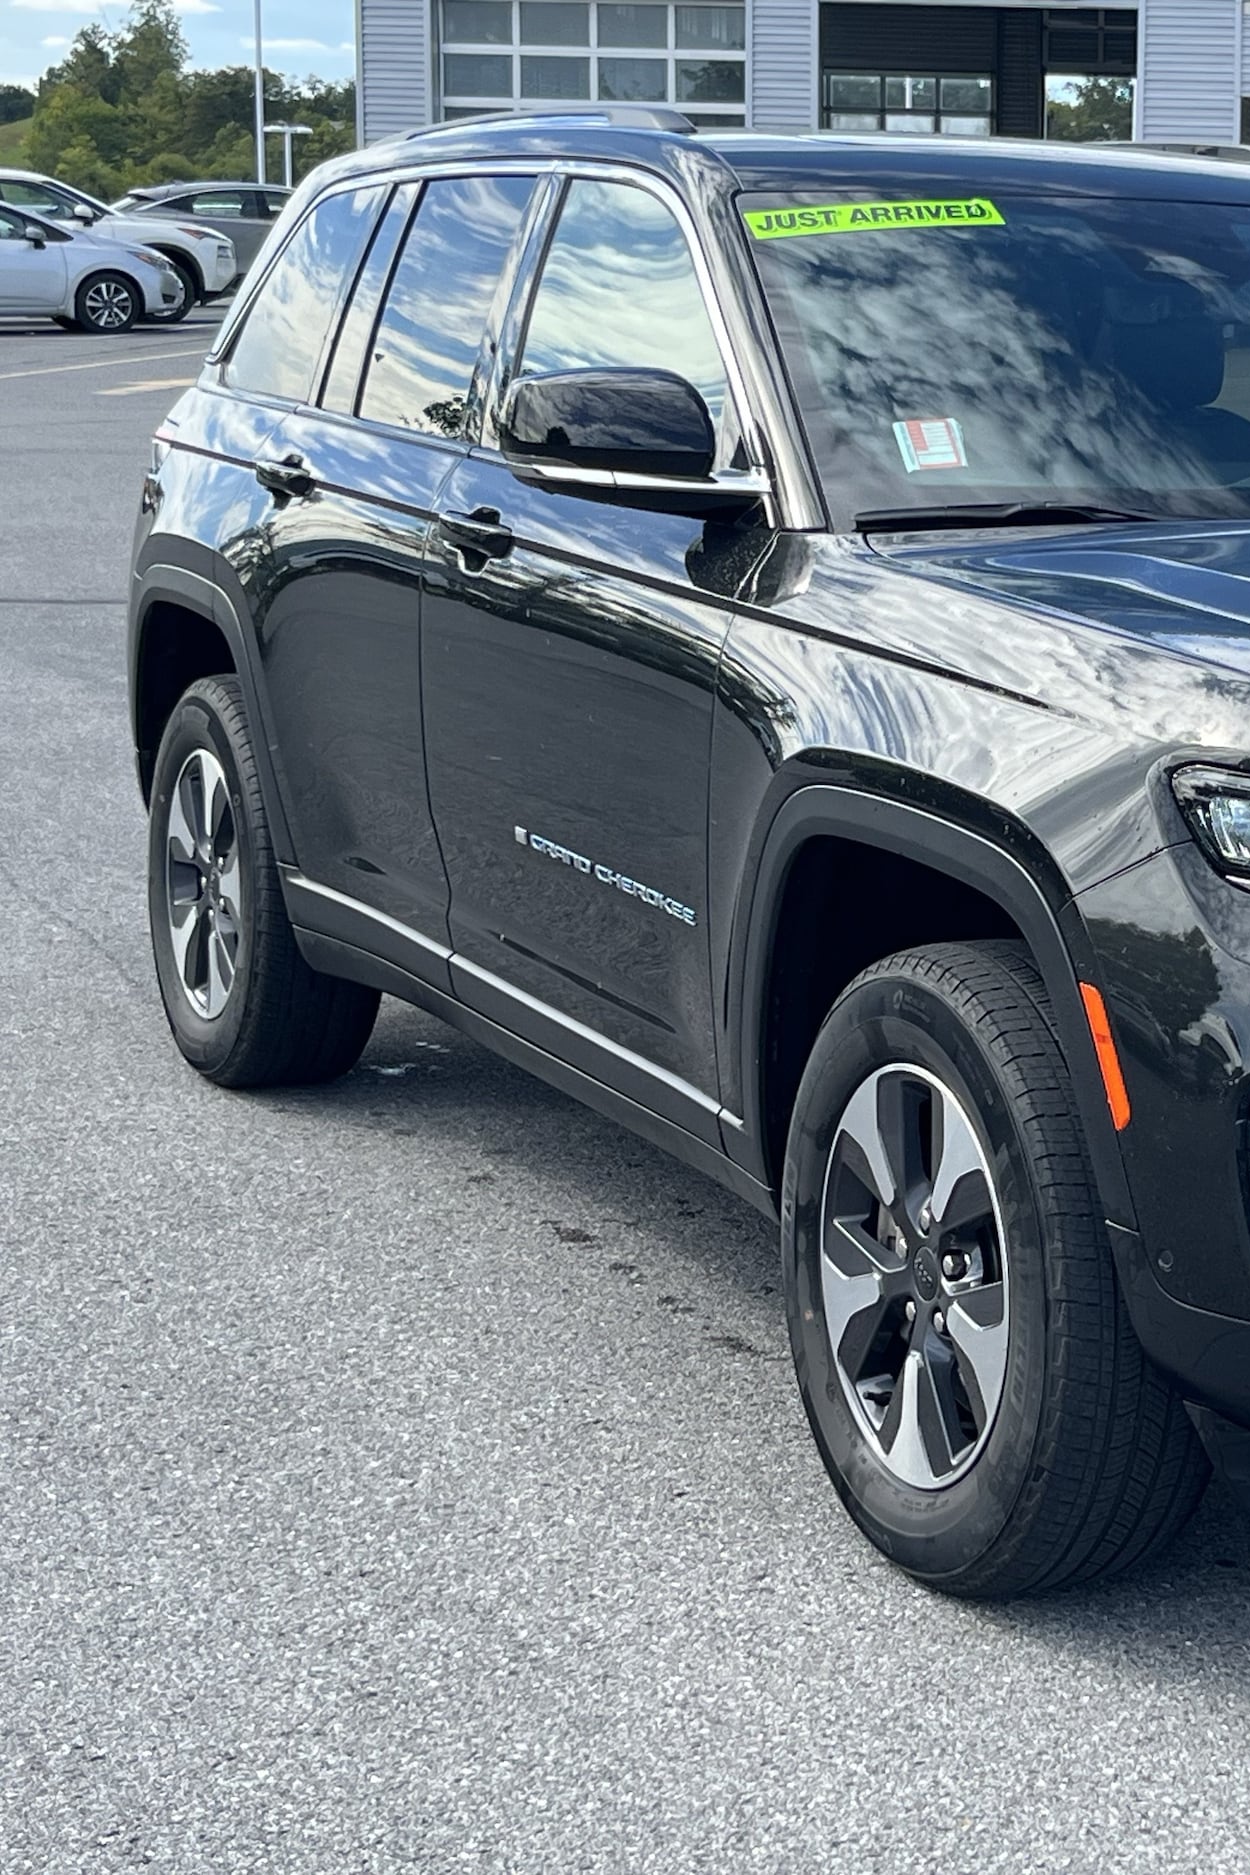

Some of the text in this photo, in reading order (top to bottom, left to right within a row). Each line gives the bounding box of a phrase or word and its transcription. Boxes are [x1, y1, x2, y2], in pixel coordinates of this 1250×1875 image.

[756, 203, 988, 232] JUST ARRIVED
[529, 833, 697, 927] GRAND CHEROKEE
